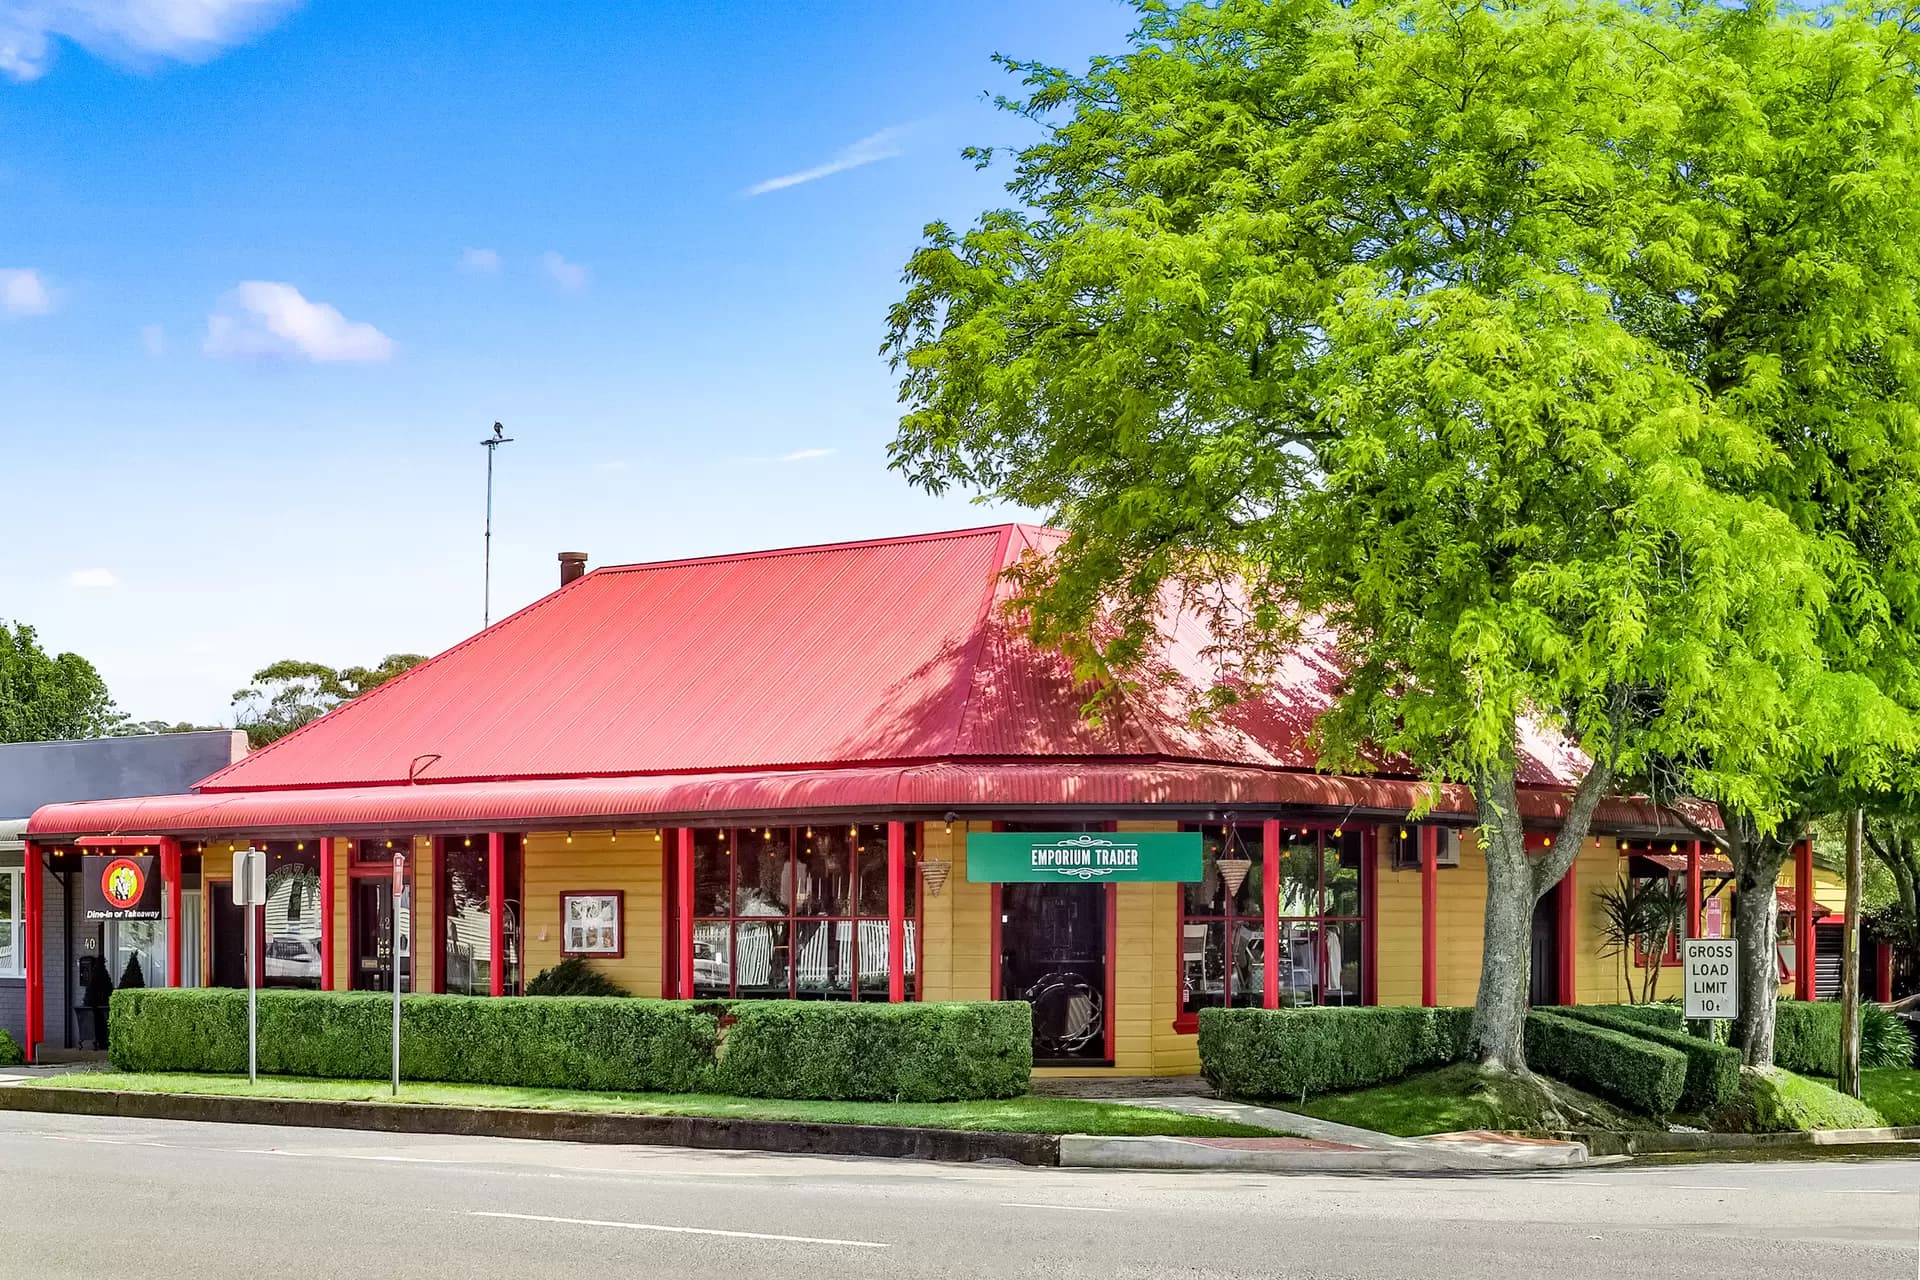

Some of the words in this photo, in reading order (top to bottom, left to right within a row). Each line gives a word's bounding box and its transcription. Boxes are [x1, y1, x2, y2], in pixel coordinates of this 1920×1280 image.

[1031, 849, 1091, 866] EMPORIUM
[1095, 849, 1138, 866] TRADER
[87, 910, 113, 919] Dine-in
[124, 910, 159, 919] Takeaway
[84, 938, 96, 950] 40
[1688, 946, 1733, 958] GROSS
[1692, 964, 1729, 976] LOAD
[1694, 982, 1727, 993] LIMIT
